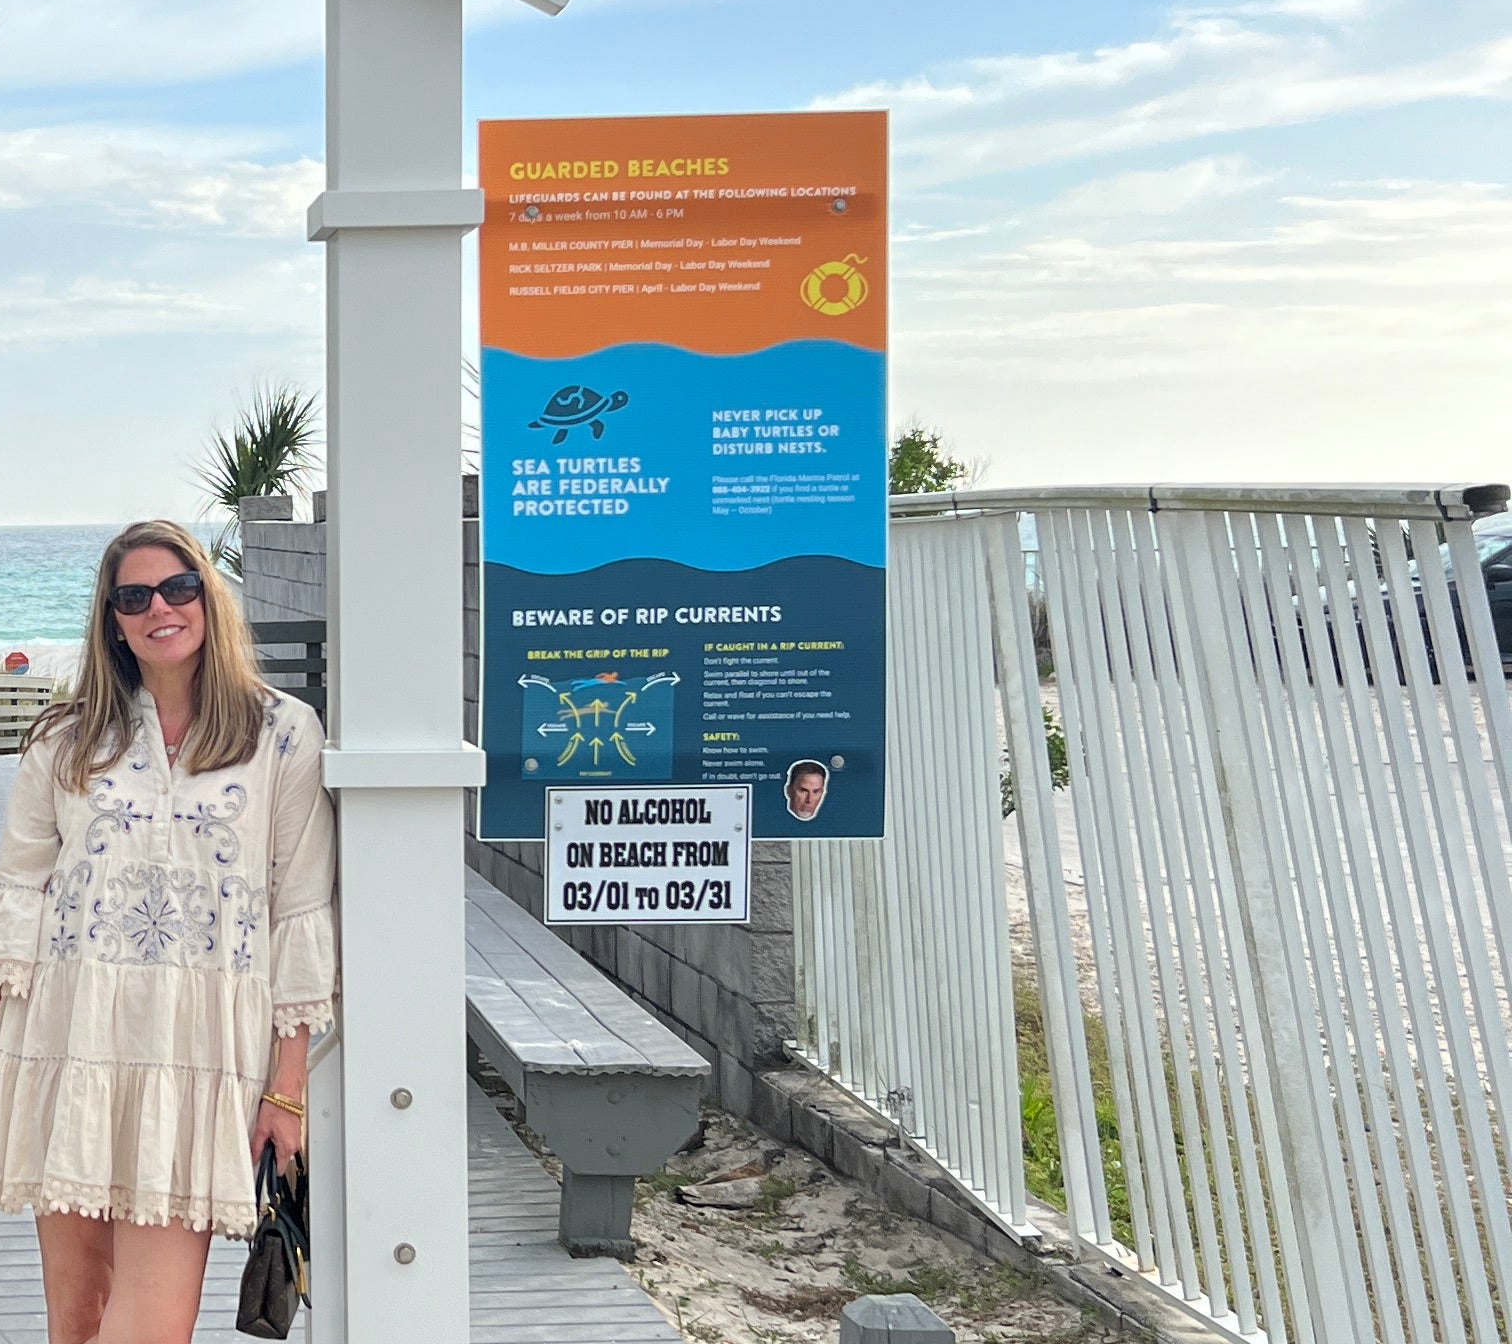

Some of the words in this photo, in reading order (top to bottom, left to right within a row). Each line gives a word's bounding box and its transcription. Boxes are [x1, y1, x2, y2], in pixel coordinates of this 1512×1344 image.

[509, 160, 619, 180] GUARDED
[627, 158, 729, 177] BEACHES
[509, 192, 581, 204] LIFEGUARDS
[582, 191, 609, 202] CAN
[611, 191, 627, 201] BE
[629, 190, 673, 201] FOUND
[674, 189, 690, 200] AT
[692, 189, 715, 199] THE
[718, 187, 788, 199] FOLLOWING
[790, 186, 857, 197] LOCATIONS
[509, 212, 516, 222] 7
[545, 213, 553, 222] a
[554, 211, 583, 221] week
[584, 209, 611, 221] from
[613, 209, 627, 220] 10
[628, 209, 648, 220] AM
[655, 208, 664, 219] 6
[665, 208, 684, 218] PM
[532, 241, 568, 251] MILLER
[569, 240, 610, 250] COUNTY
[611, 239, 634, 249] PIER
[640, 238, 685, 249] Memorial
[685, 238, 704, 249] Day
[710, 238, 738, 247] Labor
[739, 237, 758, 248] Day
[758, 236, 802, 246] Weekend
[509, 264, 532, 274] RICK
[533, 263, 575, 273] SELTZER
[576, 262, 603, 272] PARK
[608, 261, 653, 271] Memorial
[654, 261, 673, 272] Day
[679, 261, 707, 270] Labor
[708, 260, 727, 271] Day
[727, 259, 771, 269] Weekend
[509, 286, 552, 296] RUSSELL
[553, 285, 587, 295] FIELDS
[587, 284, 611, 294] CITY
[612, 284, 635, 294] PIER
[641, 283, 663, 295] April
[670, 283, 697, 293] Labor
[698, 282, 717, 293] Day
[718, 282, 761, 291] Weekend
[712, 409, 761, 422] NEVER
[765, 409, 798, 421] PICK
[802, 408, 823, 421] UP
[712, 426, 749, 439] BABY
[753, 425, 814, 438] TURTLES
[817, 425, 840, 437] OR
[712, 442, 774, 455] DISTURB
[777, 441, 827, 454] NESTS.
[512, 459, 551, 476] SEA
[556, 457, 641, 475] TURTLES
[512, 479, 552, 496] ARE
[559, 477, 670, 495] FEDERALLY
[512, 498, 629, 516] PROTECTED
[512, 609, 594, 627] BEWARE
[600, 608, 629, 625] OF
[635, 608, 669, 624] RIP
[674, 606, 782, 624] CURRENTS
[527, 650, 561, 660] BREAK
[563, 650, 584, 659] THE
[585, 649, 611, 659] GRIP
[612, 649, 627, 658] OF
[629, 648, 650, 658] THE
[651, 648, 669, 657] RIP
[704, 643, 714, 651] IF
[715, 642, 755, 652] CAUGHT
[756, 642, 769, 651] IN
[779, 642, 796, 650] RIP
[584, 799, 613, 826] NO
[617, 798, 712, 825] ALCOHOL
[566, 842, 594, 869] ON
[598, 841, 668, 868] BEACH
[672, 840, 730, 867] FROM
[563, 879, 629, 912] 03/01
[634, 886, 660, 910] TO
[665, 878, 732, 912] 03/31
